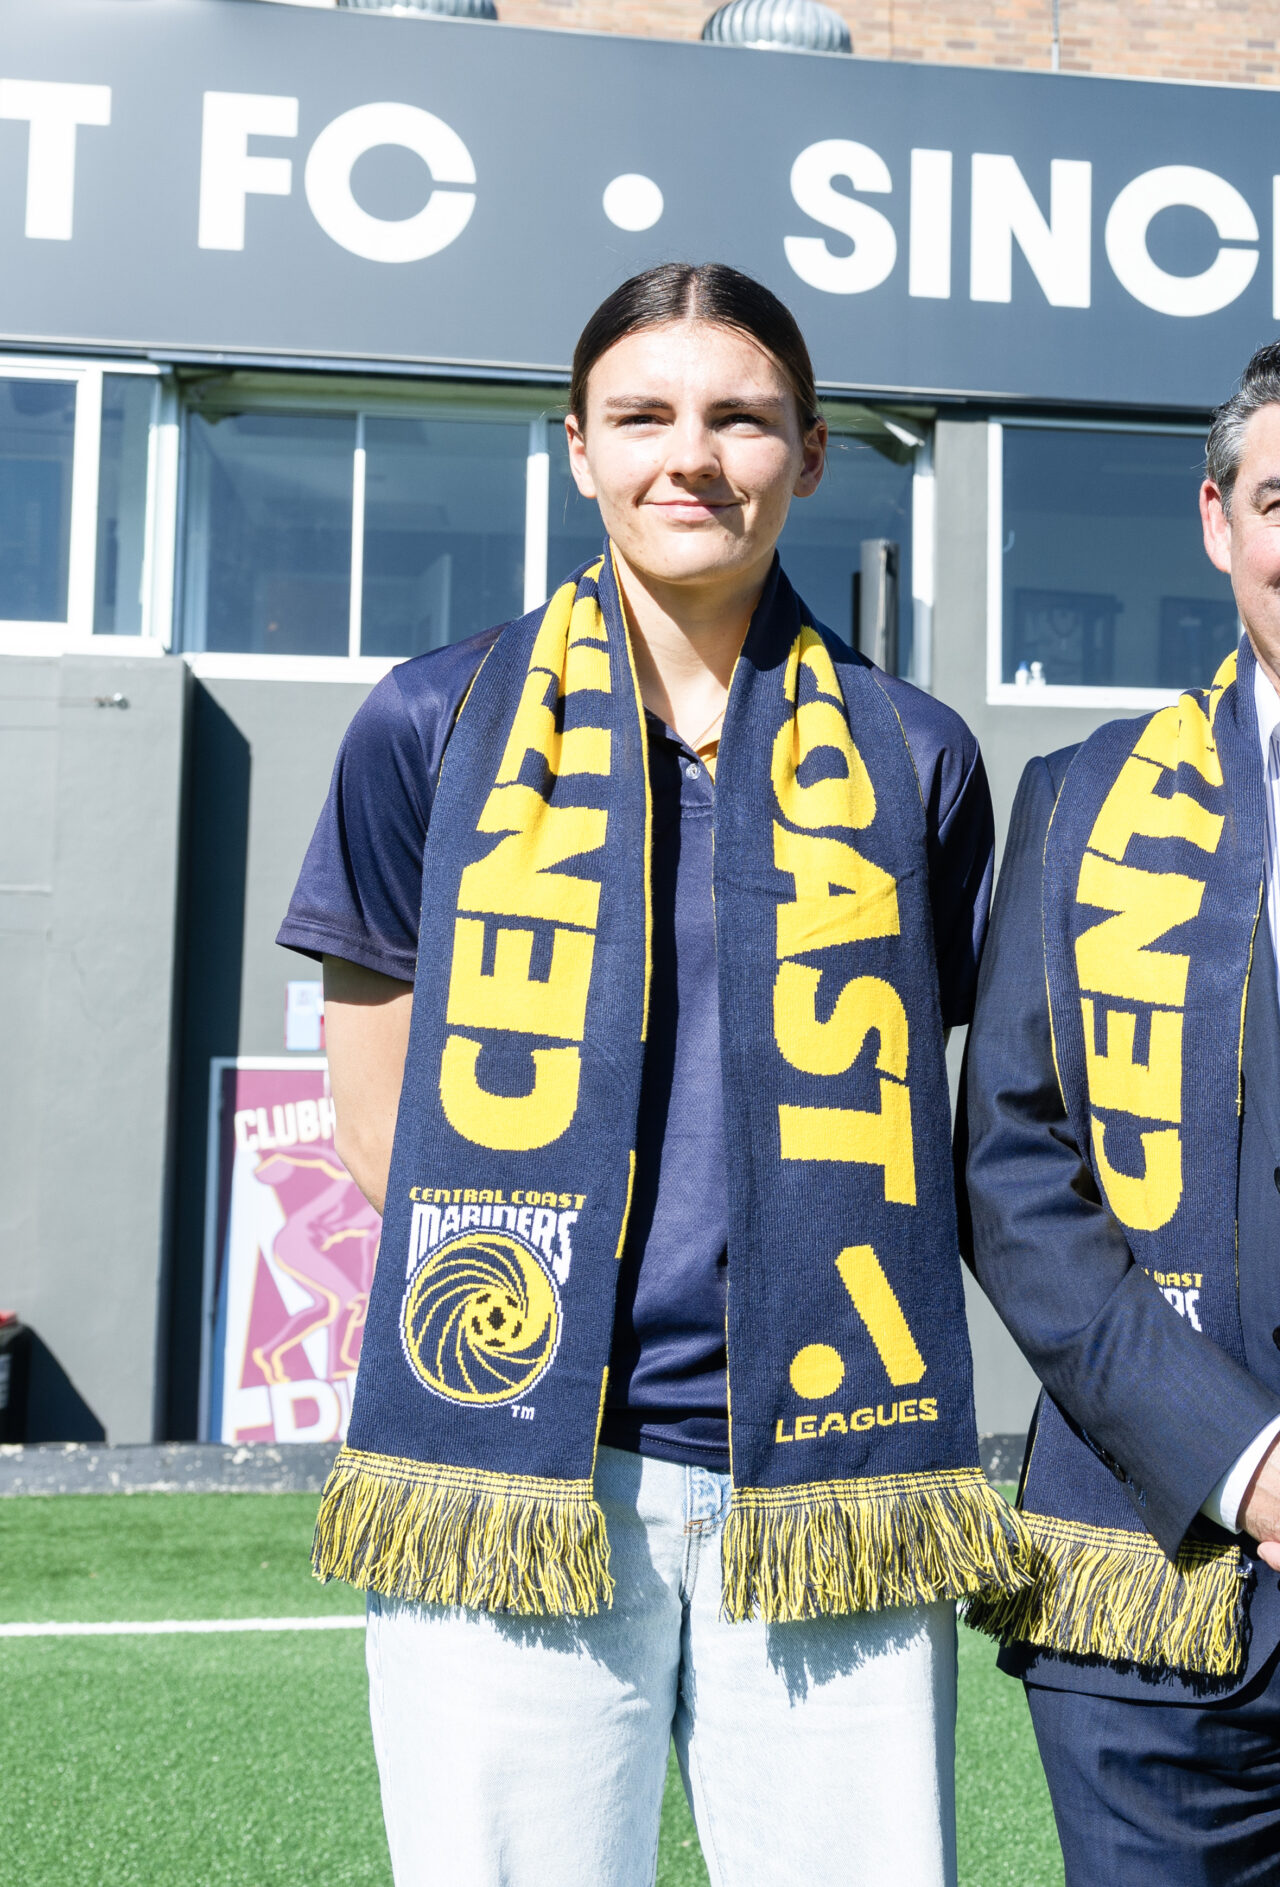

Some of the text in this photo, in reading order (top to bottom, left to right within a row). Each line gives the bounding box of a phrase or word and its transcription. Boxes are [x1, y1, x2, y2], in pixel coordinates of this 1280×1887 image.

[199, 91, 477, 263] FC
[409, 1186, 587, 1210] CENTRAL COAST
[405, 1202, 578, 1286] MARINERS
[511, 1405, 535, 1420] TM
[775, 1397, 938, 1443] LEAGUES
